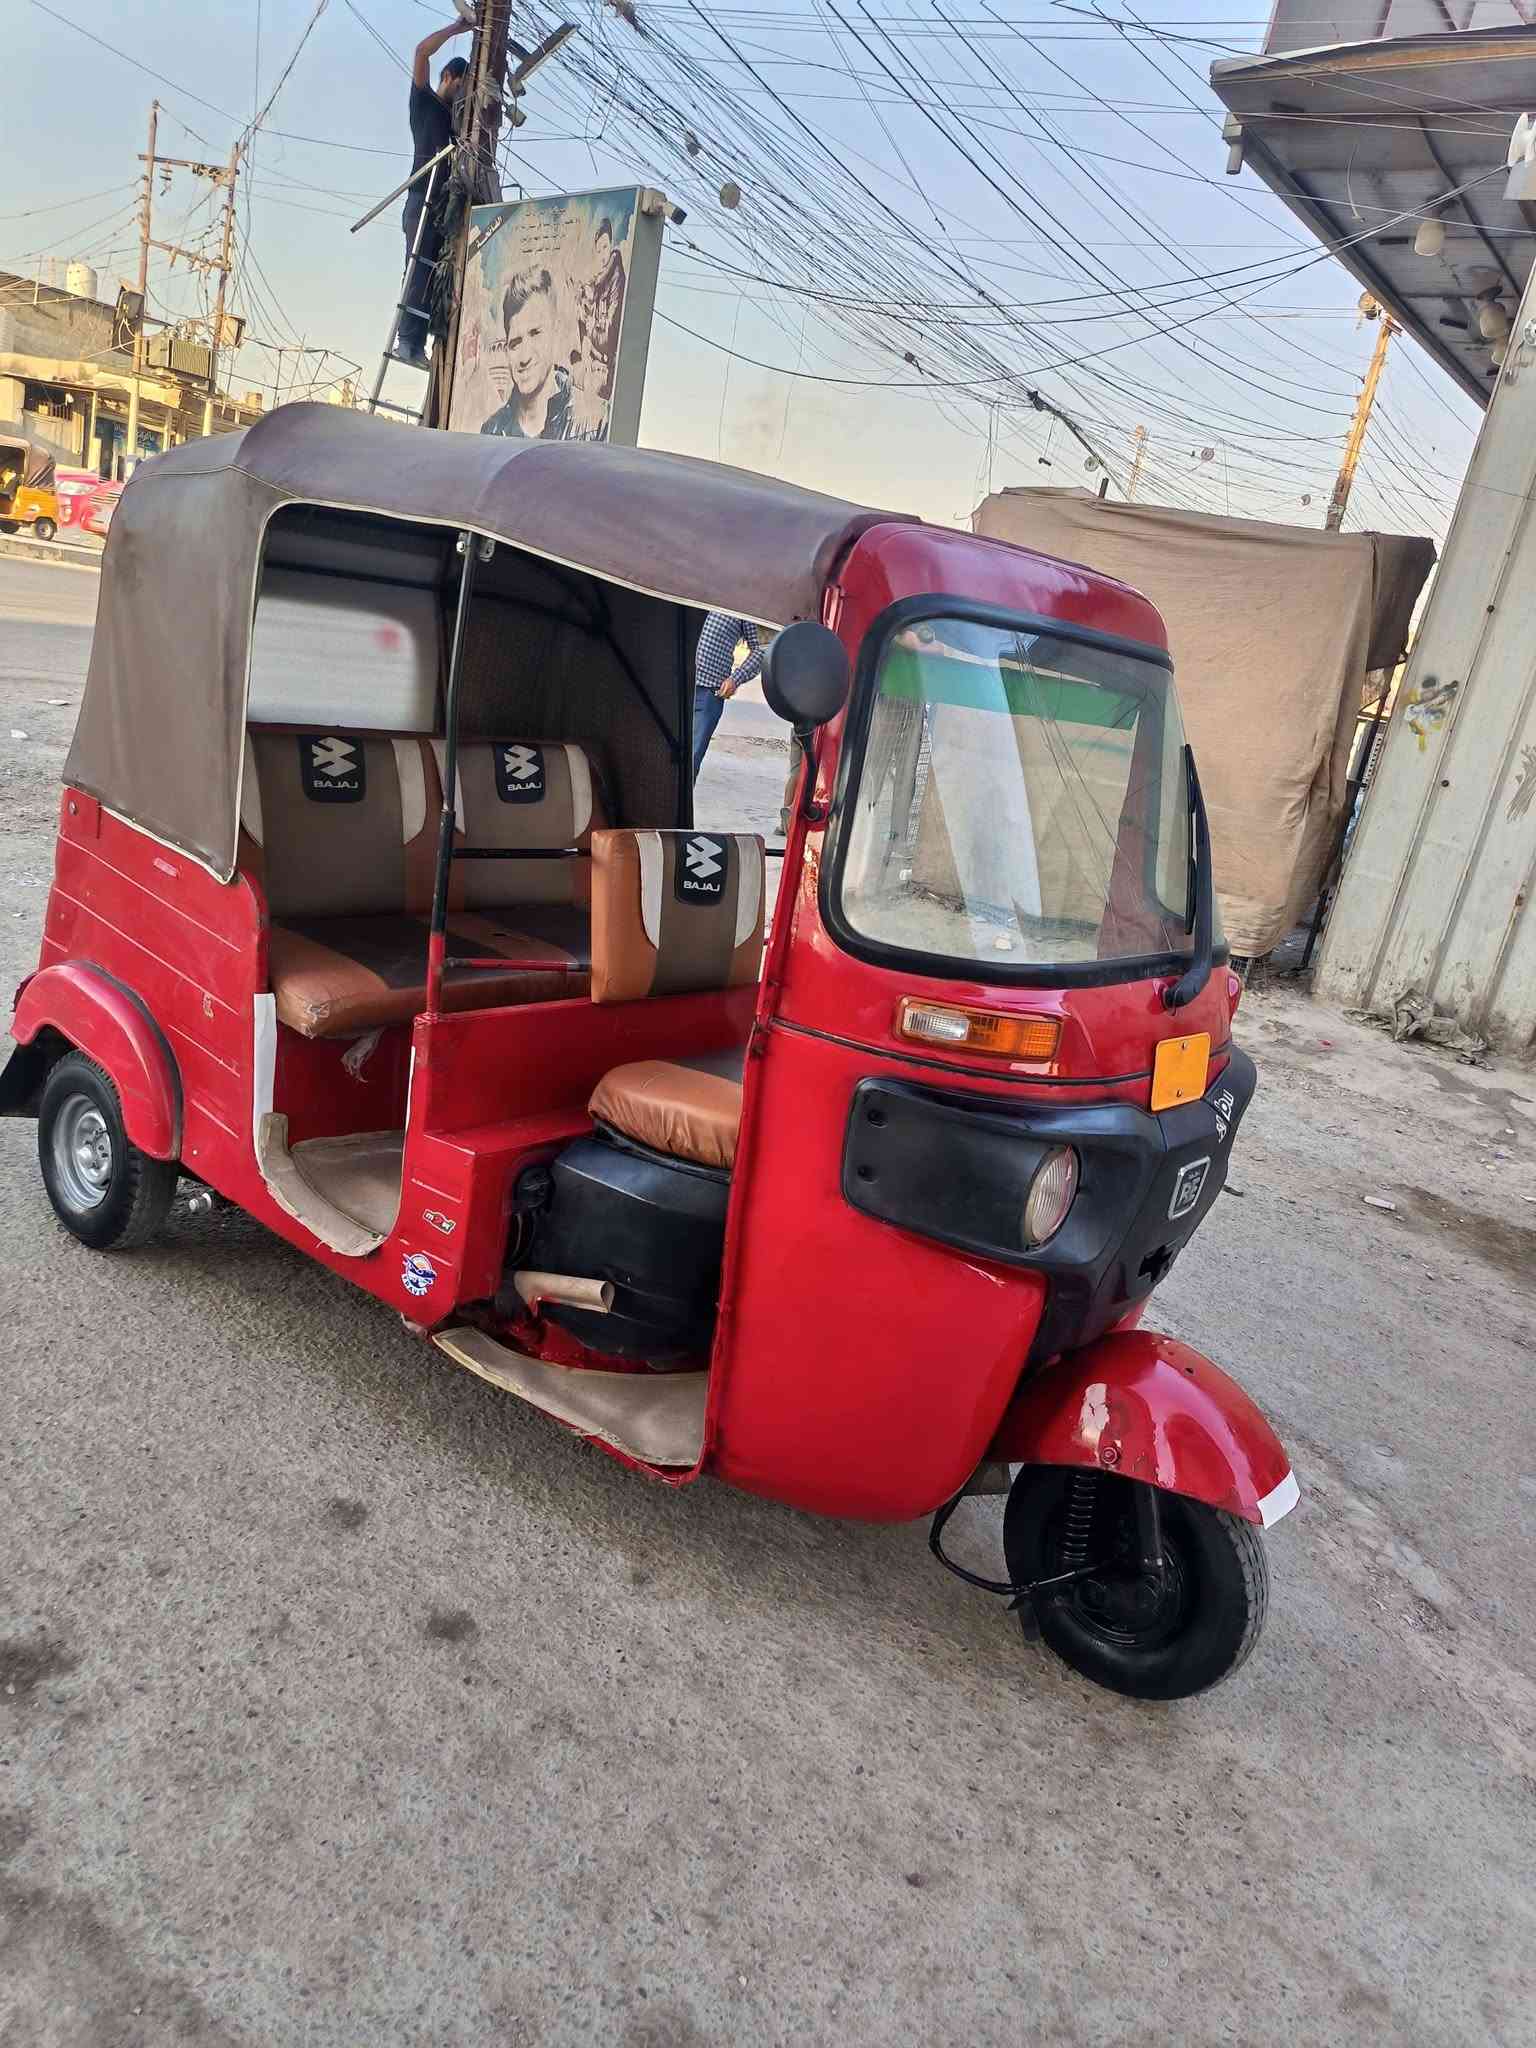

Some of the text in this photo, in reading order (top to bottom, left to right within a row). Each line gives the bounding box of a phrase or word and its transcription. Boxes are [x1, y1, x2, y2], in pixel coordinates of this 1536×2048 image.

[313, 780, 359, 789] BAJAJ
[507, 781, 542, 791] BAJAJ
[683, 880, 721, 892] BAJAJ
